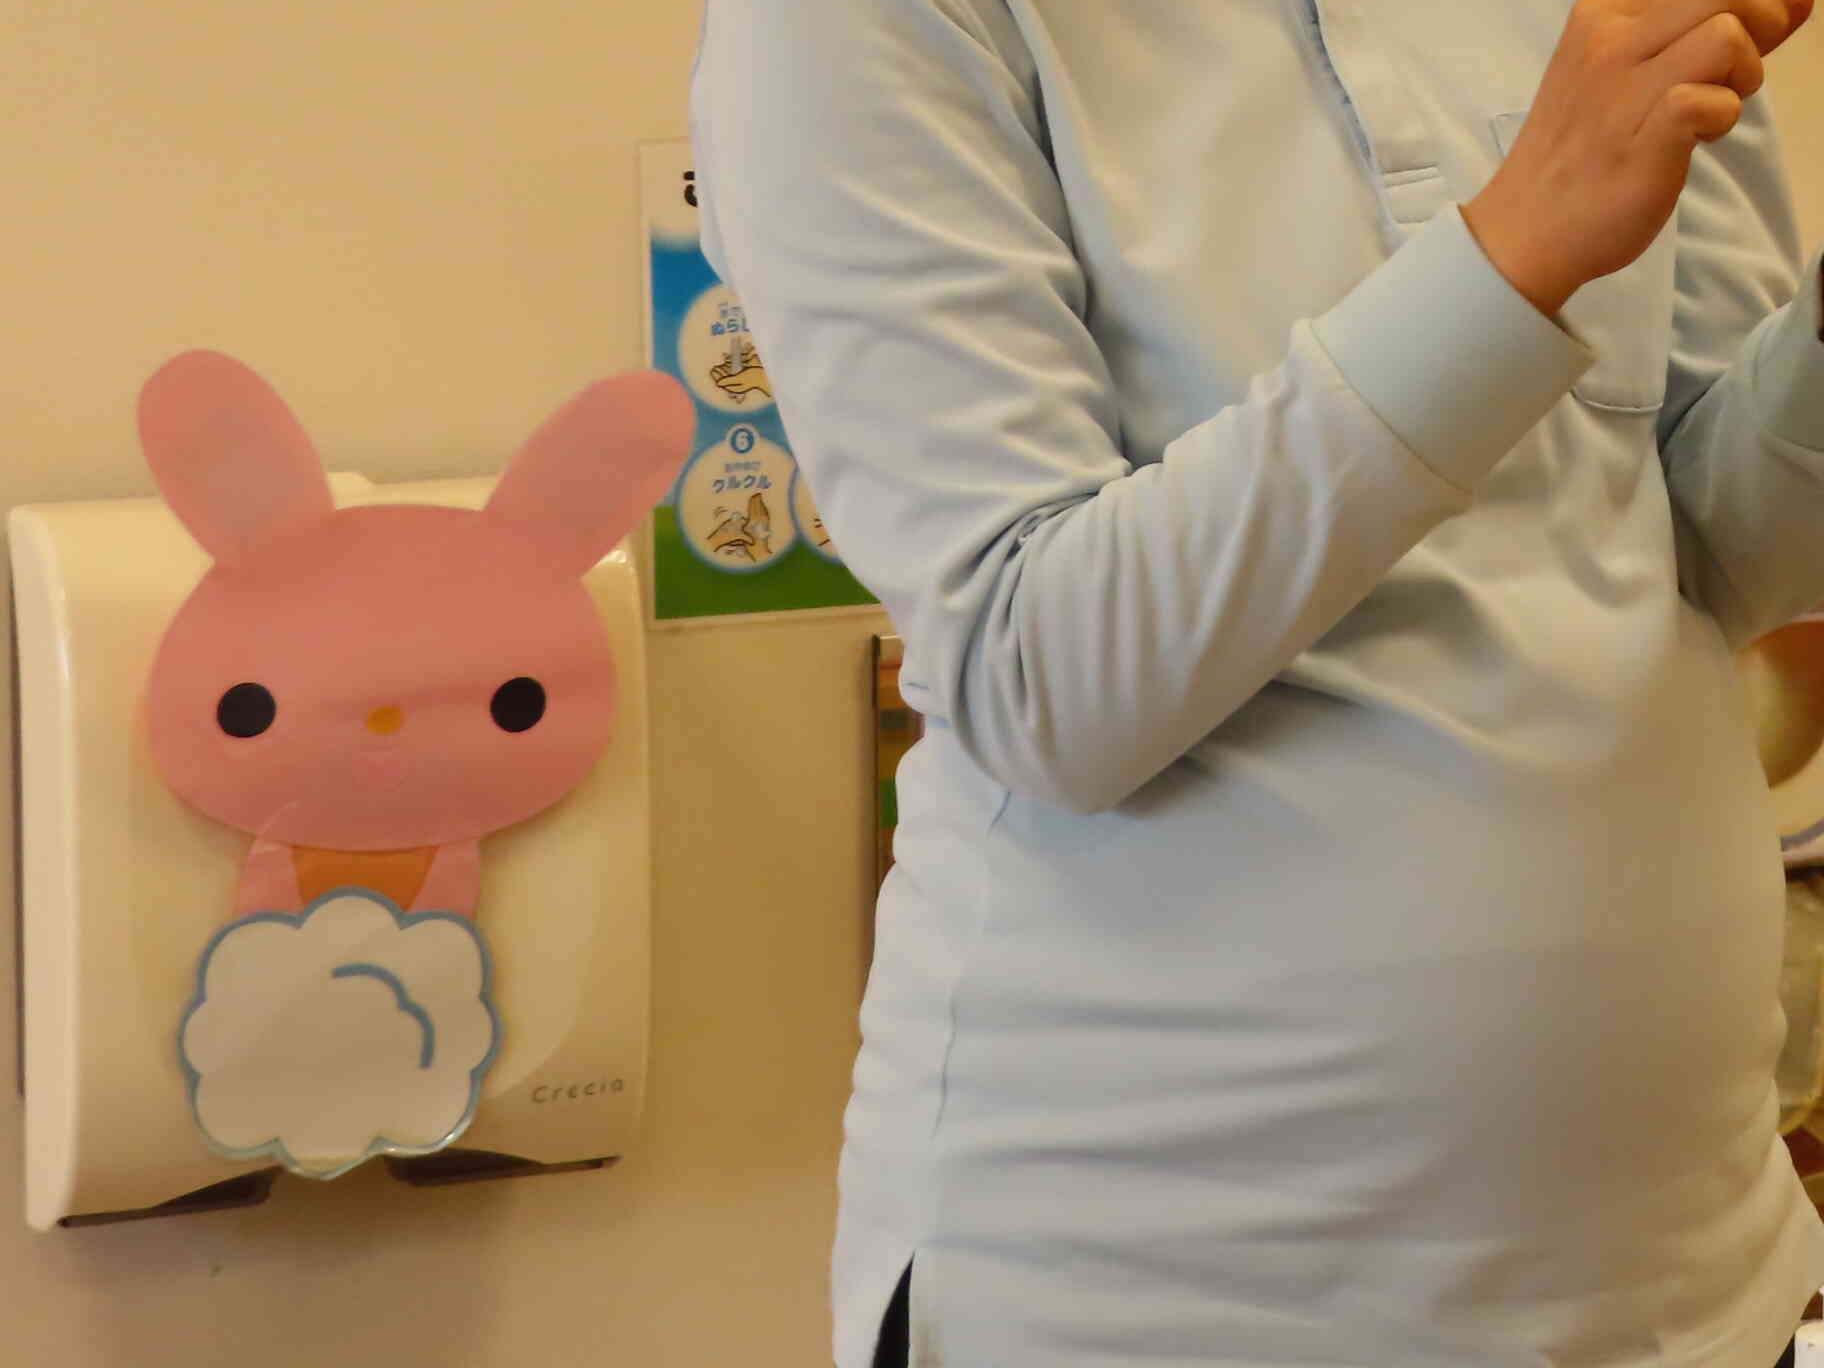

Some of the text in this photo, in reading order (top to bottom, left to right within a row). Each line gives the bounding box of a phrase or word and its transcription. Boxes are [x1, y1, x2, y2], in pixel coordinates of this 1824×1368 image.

[735, 430, 750, 451] 6
[712, 474, 772, 494] クルクル
[531, 1078, 623, 1104] Crecia
